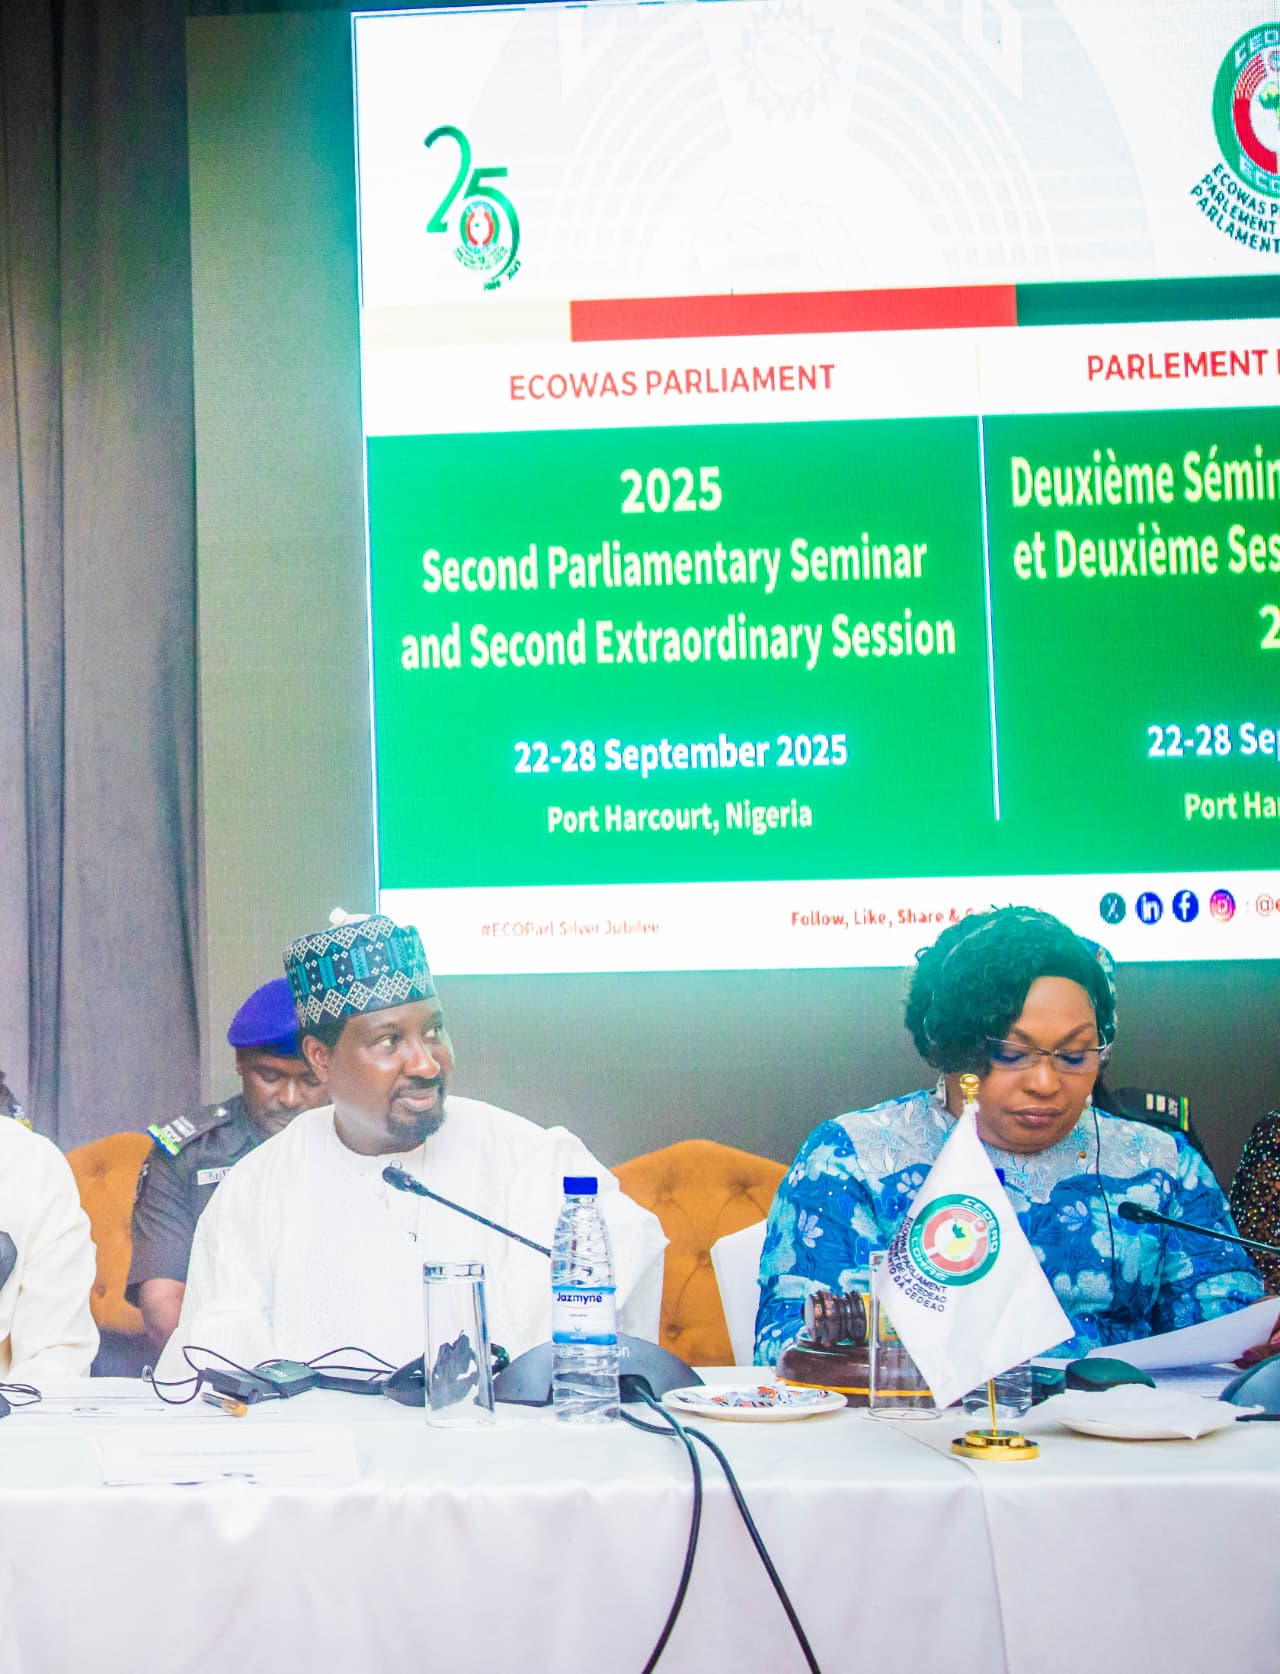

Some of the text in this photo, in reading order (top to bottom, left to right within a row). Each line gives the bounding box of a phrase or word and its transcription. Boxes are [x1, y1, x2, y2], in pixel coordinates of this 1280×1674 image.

[424, 125, 520, 280] 25
[1201, 174, 1276, 235] PARLEMENT
[1212, 163, 1265, 215] ECOWAS
[510, 364, 835, 400] ECOWAS PARLIAMENT
[1087, 349, 1269, 381] PARLEMENT
[620, 466, 723, 513] 2025
[1010, 447, 1175, 508] Deuxième
[422, 532, 929, 595] Second Parliamentary Seminar
[1013, 531, 1047, 579] et
[1055, 521, 1219, 578] Deuxième
[401, 607, 957, 671] and Second Extraordinary Session
[1258, 603, 1280, 649] 2
[514, 733, 849, 779] 22-28 September 2025
[1147, 721, 1280, 762] 22-28 Se
[547, 798, 813, 836] Port Harcourt, Nigeria
[1184, 790, 1280, 821] Port Ha
[791, 909, 849, 929] Follow,
[854, 908, 893, 928] Like,
[897, 907, 945, 924] Share
[901, 1254, 948, 1293] PARLIAMENT
[912, 1283, 947, 1303] CEDEAO
[556, 1292, 603, 1305] Jazmyne
[905, 1287, 945, 1312] CEDEAO
